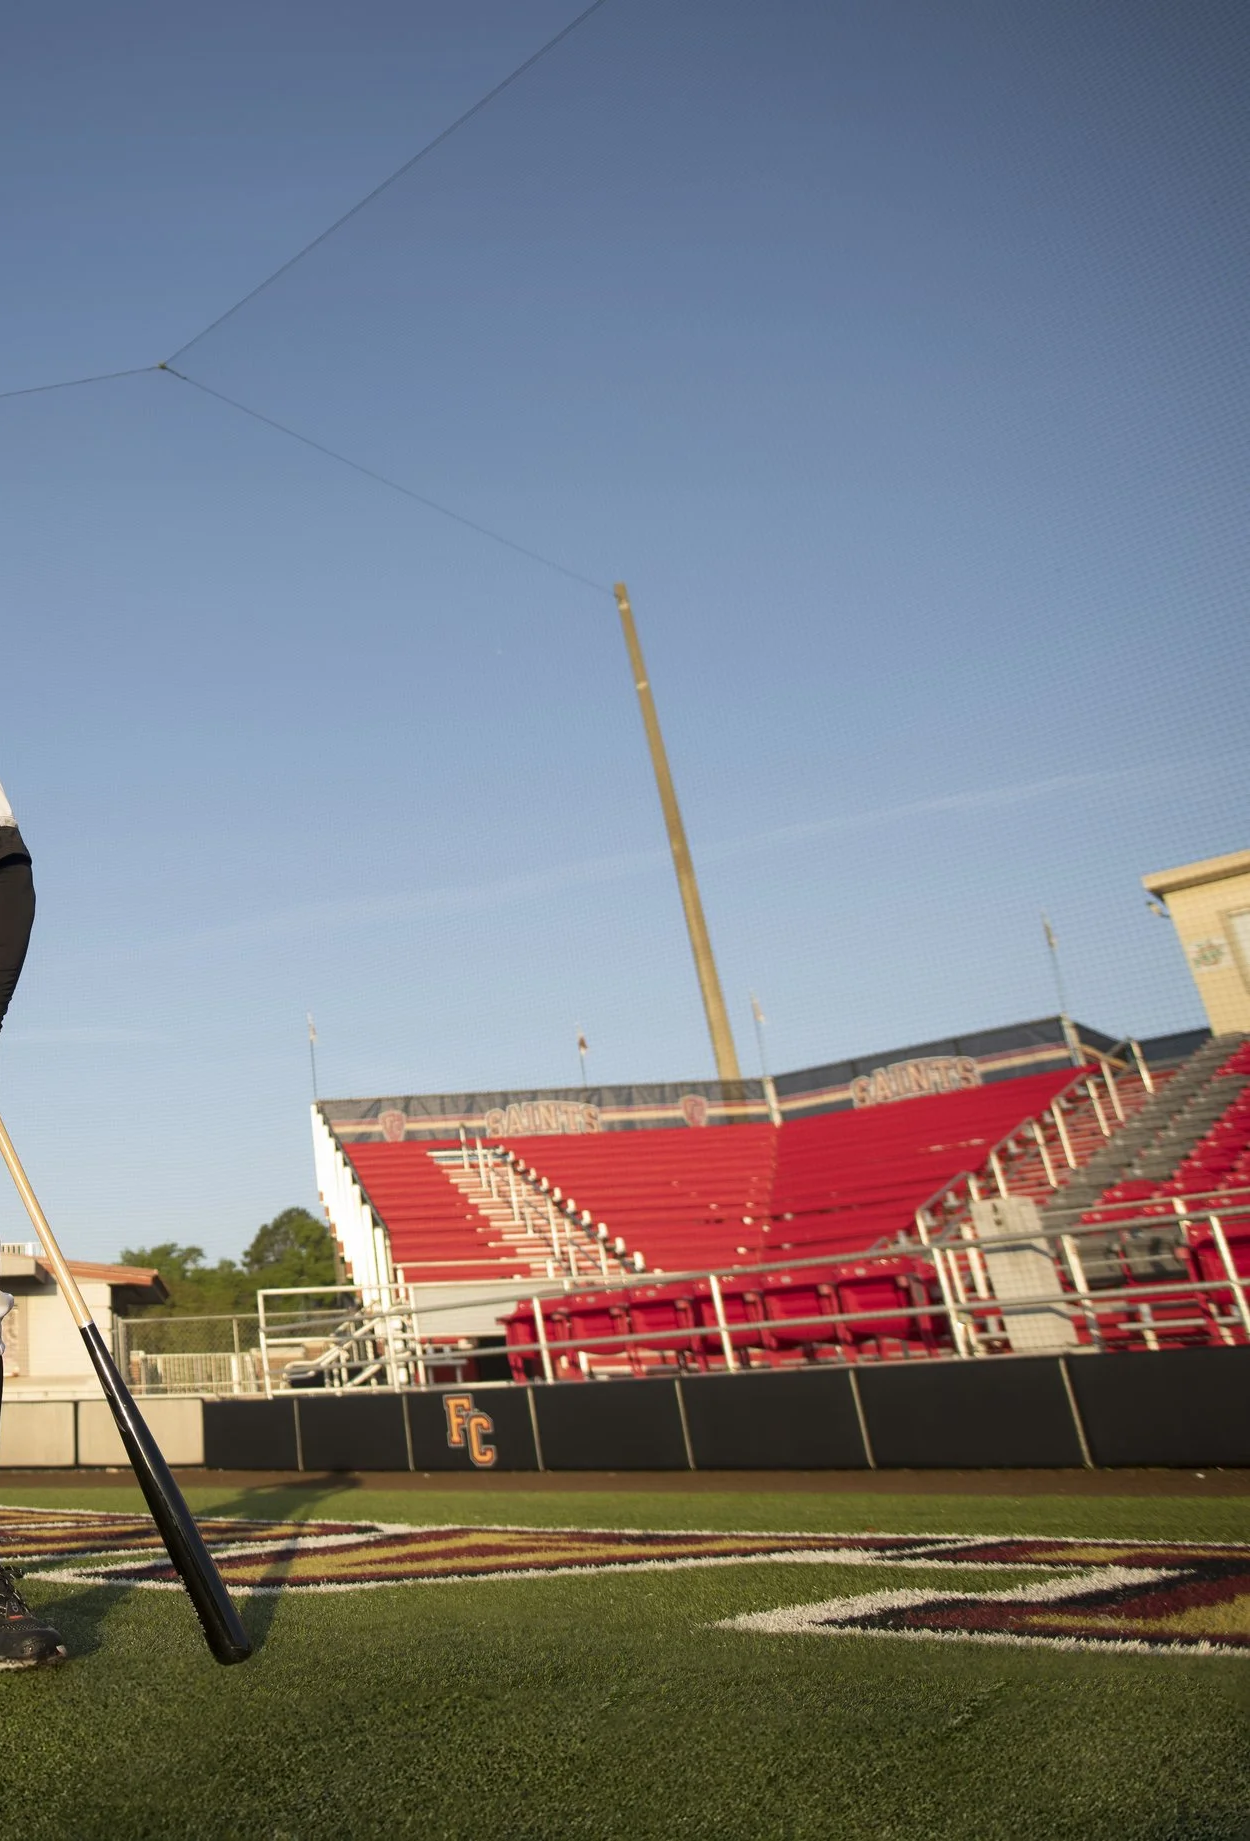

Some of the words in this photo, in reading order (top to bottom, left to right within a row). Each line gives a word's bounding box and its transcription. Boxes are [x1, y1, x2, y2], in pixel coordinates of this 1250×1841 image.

[852, 1056, 982, 1109] SAINTS
[485, 1101, 600, 1138] SAINTS
[443, 1393, 497, 1467] FC
